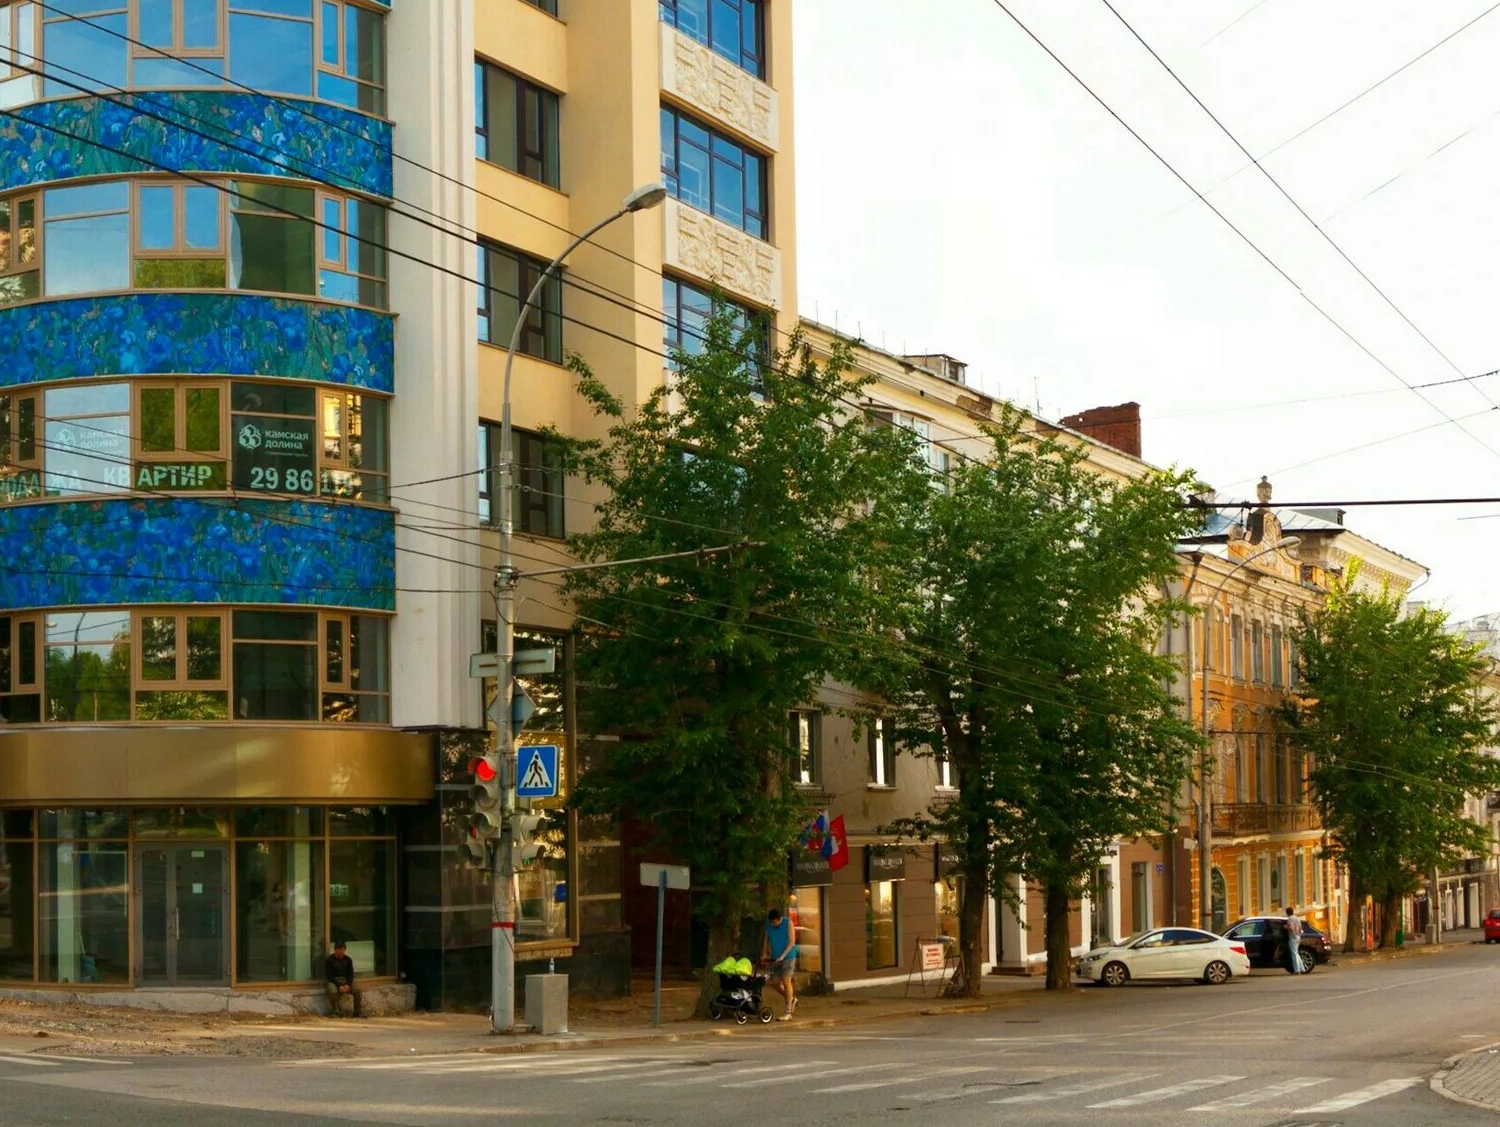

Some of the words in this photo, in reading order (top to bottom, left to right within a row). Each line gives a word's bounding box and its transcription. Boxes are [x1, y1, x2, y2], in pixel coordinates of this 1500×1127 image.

[265, 429, 309, 441] камская
[265, 440, 303, 450] долина
[250, 466, 279, 490] 29
[285, 468, 314, 491] 86
